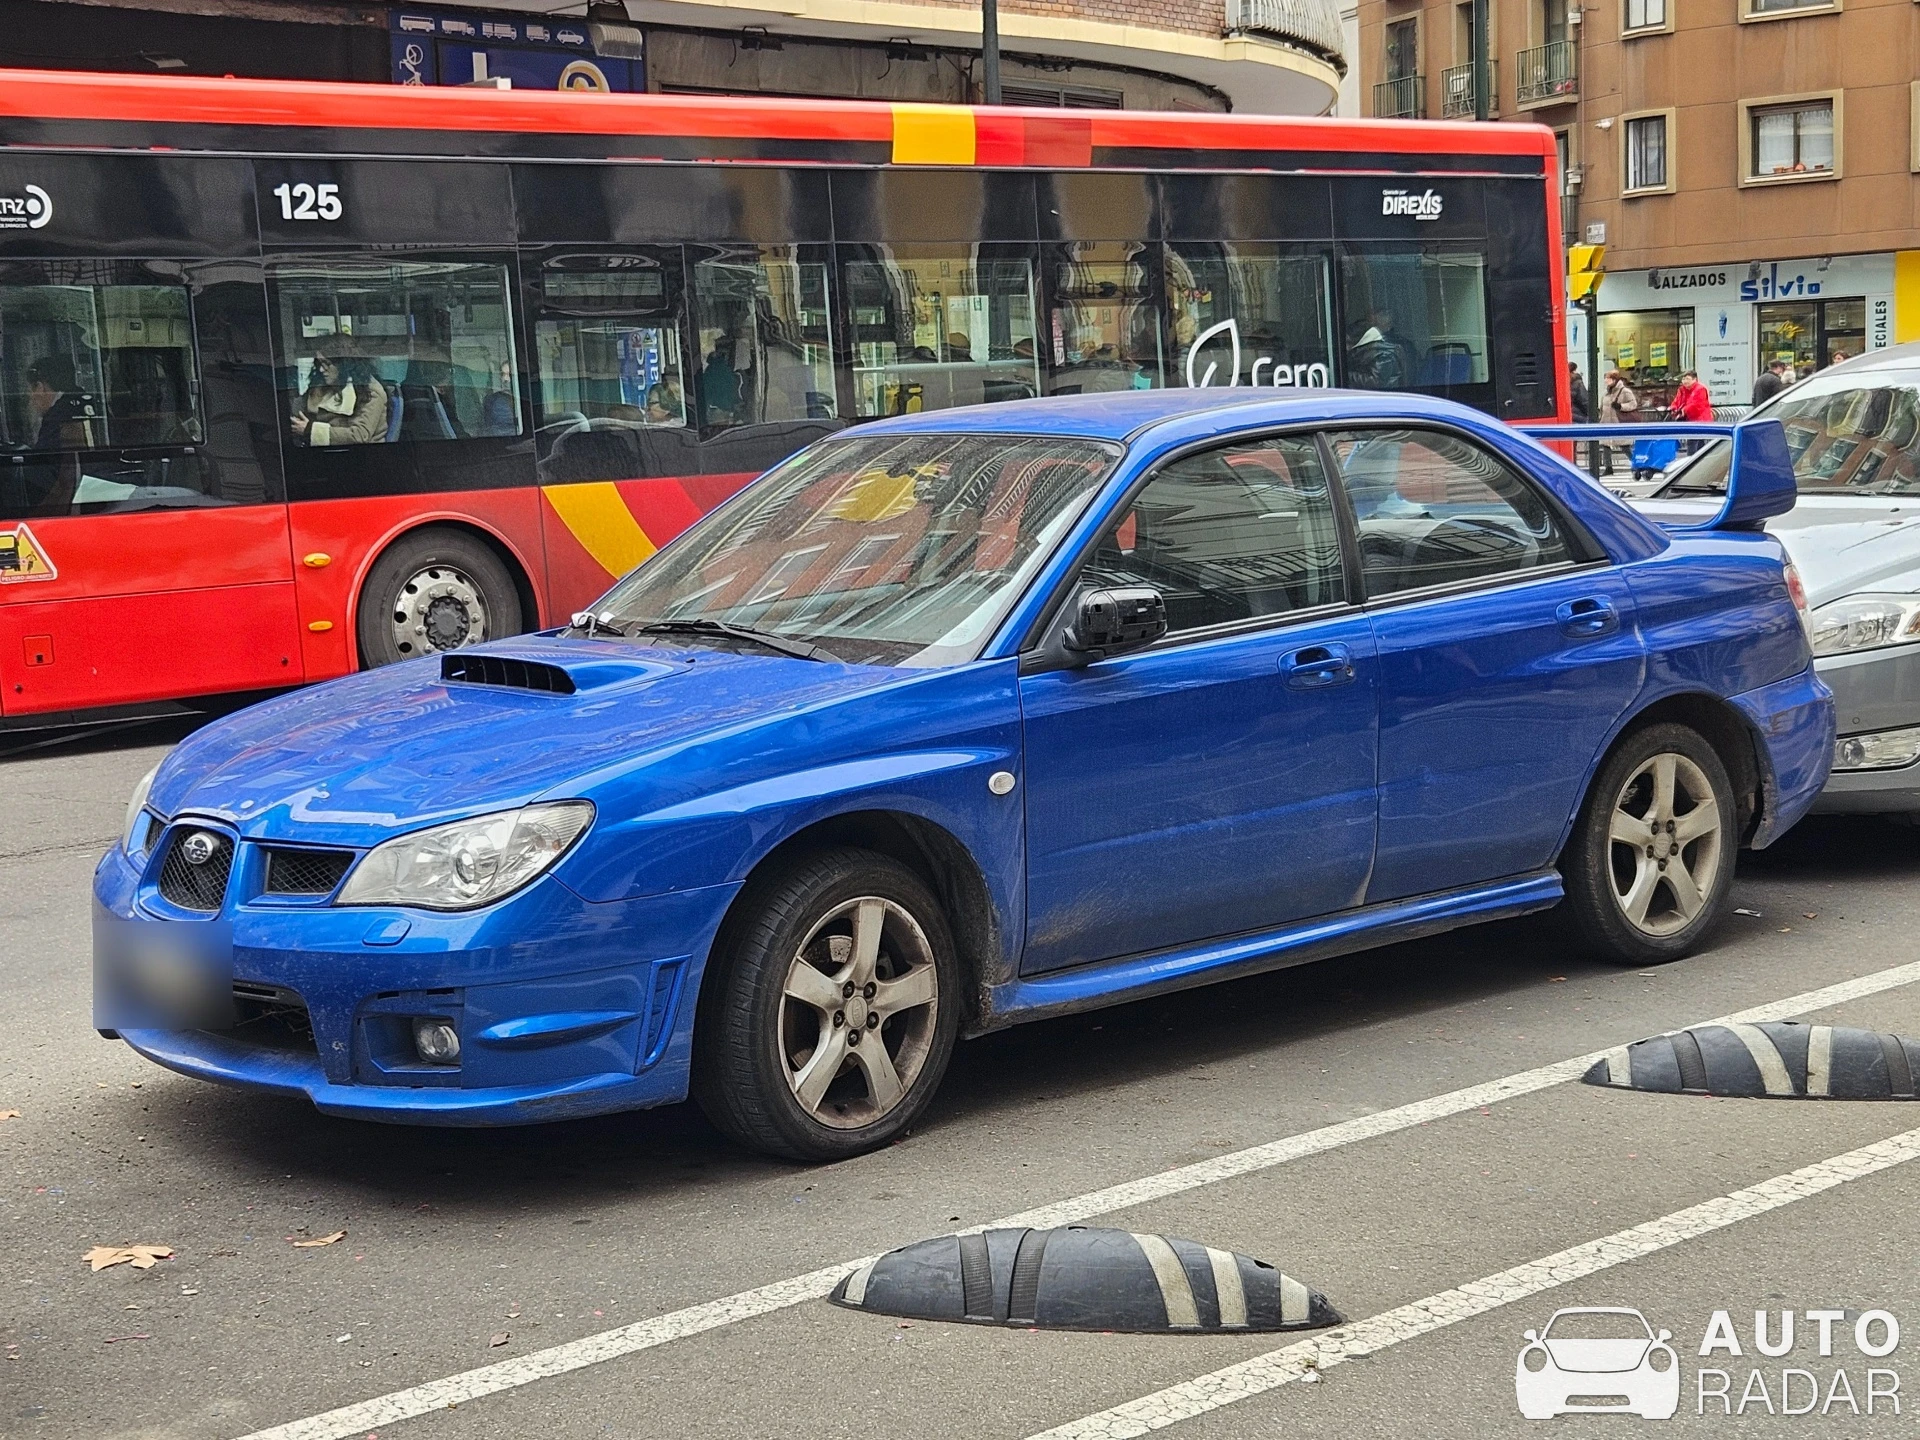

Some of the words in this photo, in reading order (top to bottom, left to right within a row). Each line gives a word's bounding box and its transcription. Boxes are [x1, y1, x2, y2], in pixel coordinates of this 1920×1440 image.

[0, 198, 26, 214] TAZ
[273, 183, 342, 220] 125
[1382, 189, 1442, 215] DIREXIS
[1740, 263, 1821, 302] Silvio
[1874, 300, 1887, 349] ECIALES
[1252, 357, 1328, 388] Cero
